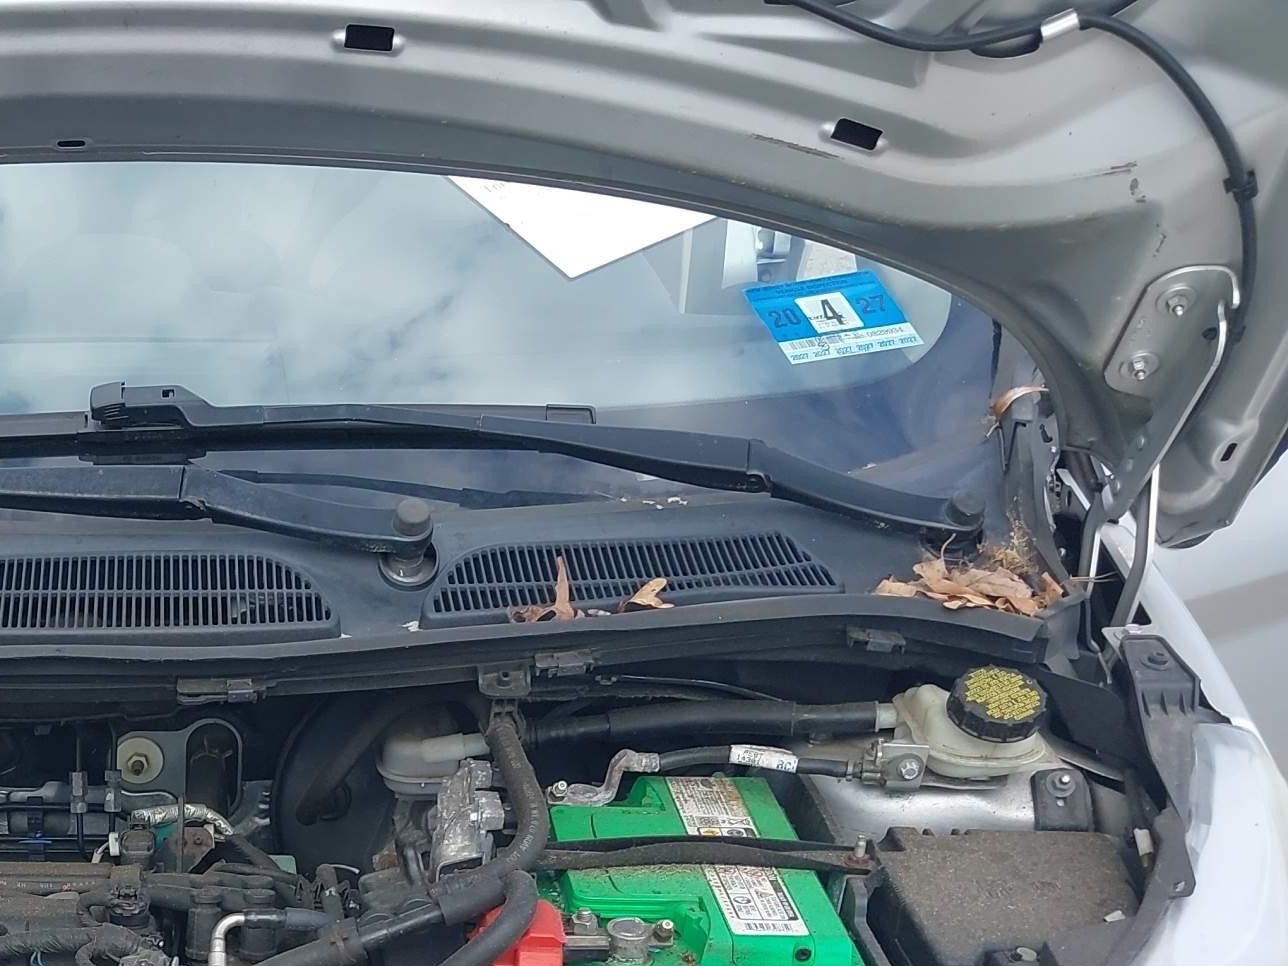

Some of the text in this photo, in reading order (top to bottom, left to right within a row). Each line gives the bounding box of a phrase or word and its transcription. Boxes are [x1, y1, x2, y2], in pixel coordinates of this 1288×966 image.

[768, 294, 886, 329] 20 4 27
